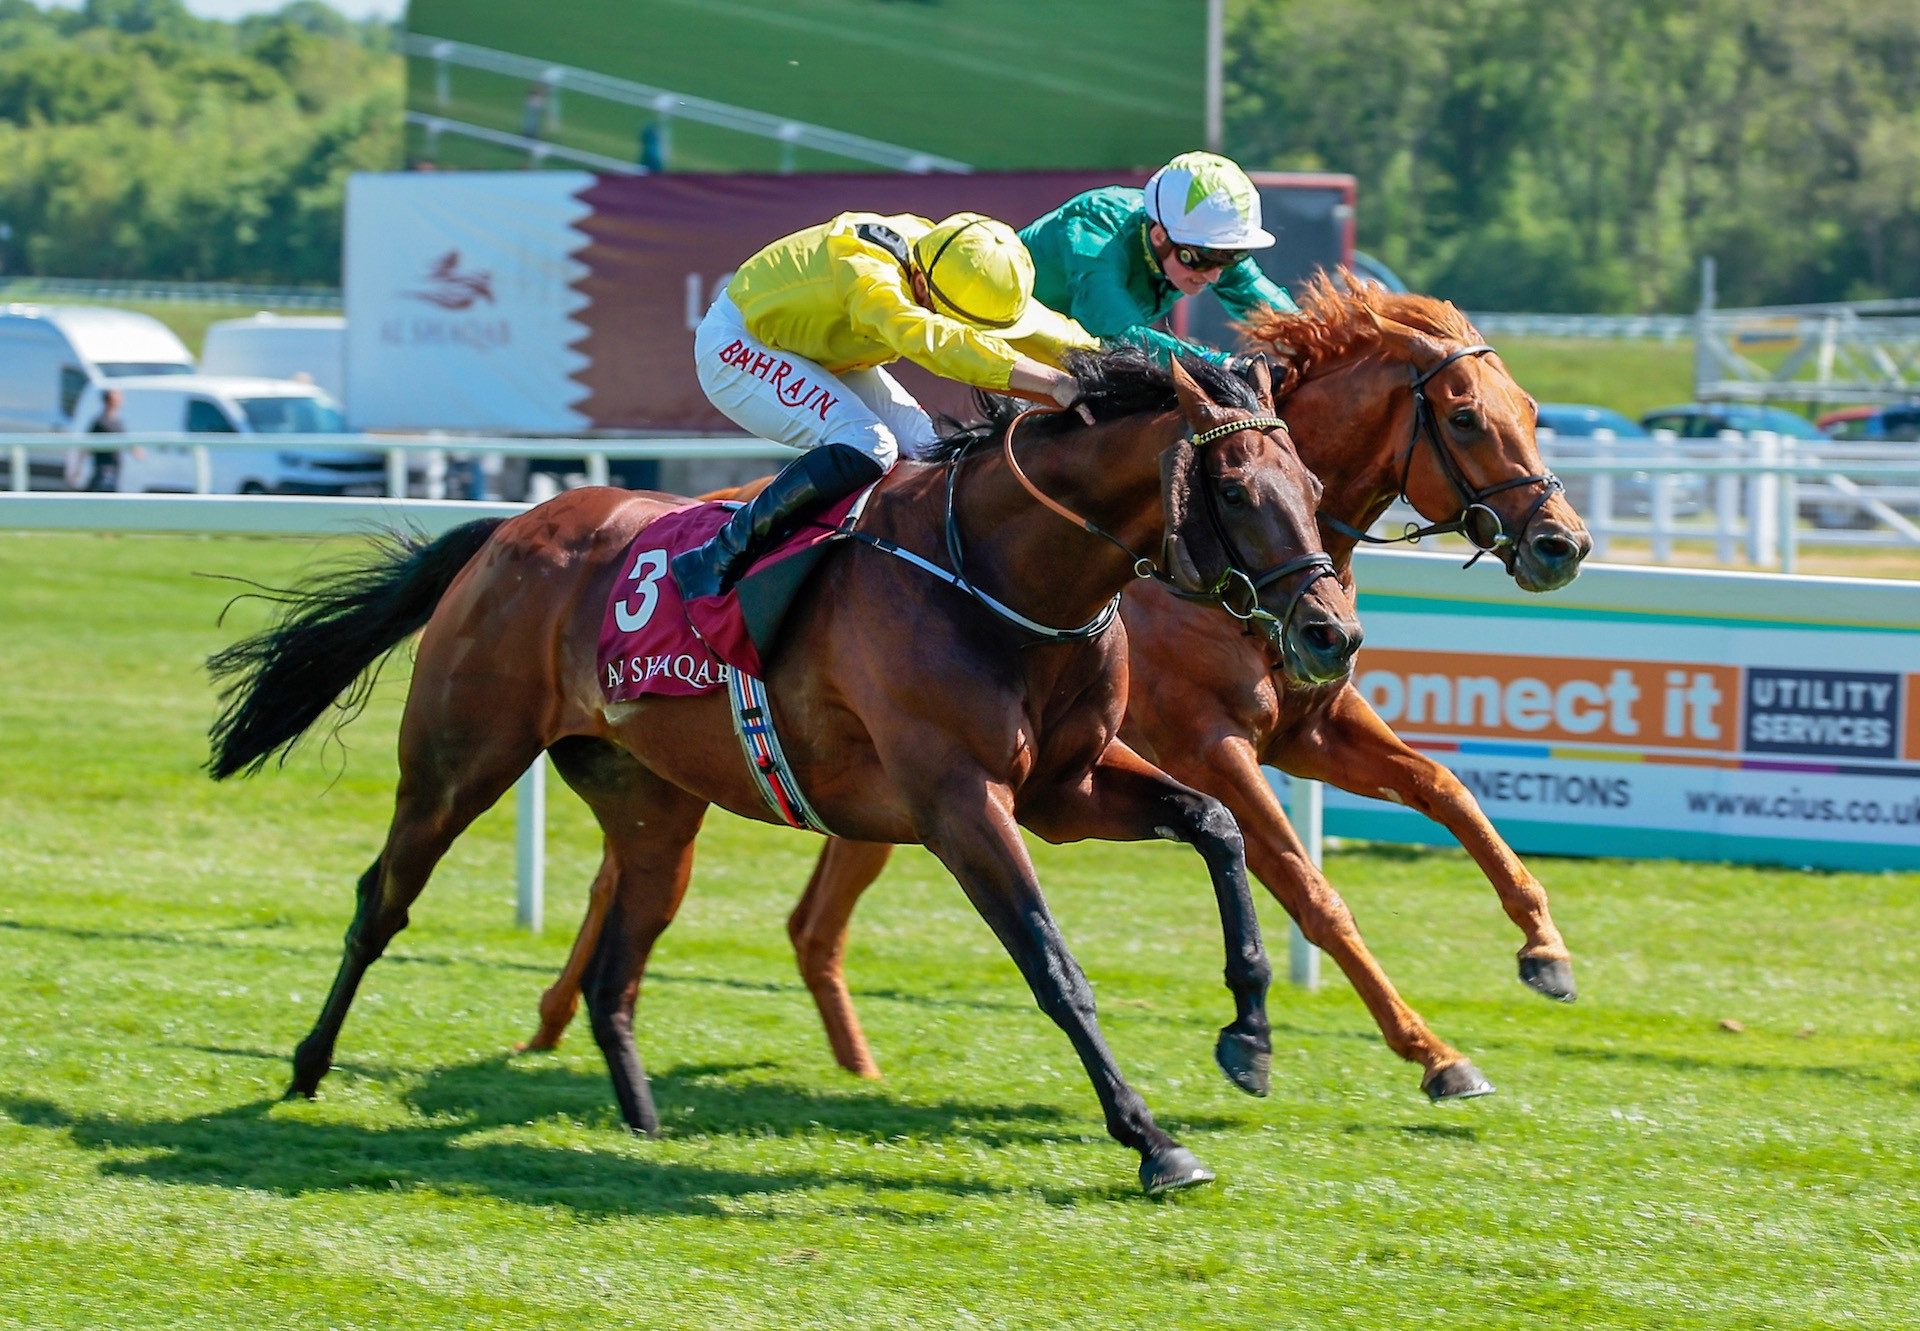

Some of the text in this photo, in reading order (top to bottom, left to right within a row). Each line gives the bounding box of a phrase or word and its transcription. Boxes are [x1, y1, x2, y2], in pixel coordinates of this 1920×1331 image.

[718, 339, 840, 421] BAHRAIN
[614, 548, 668, 632] 3
[606, 654, 730, 689] AL SHAQAB
[1359, 670, 1722, 740] onnect it
[1752, 677, 1892, 712] UTILITY
[1751, 711, 1891, 747] SERVICES
[1463, 768, 1632, 808] NECTIONS
